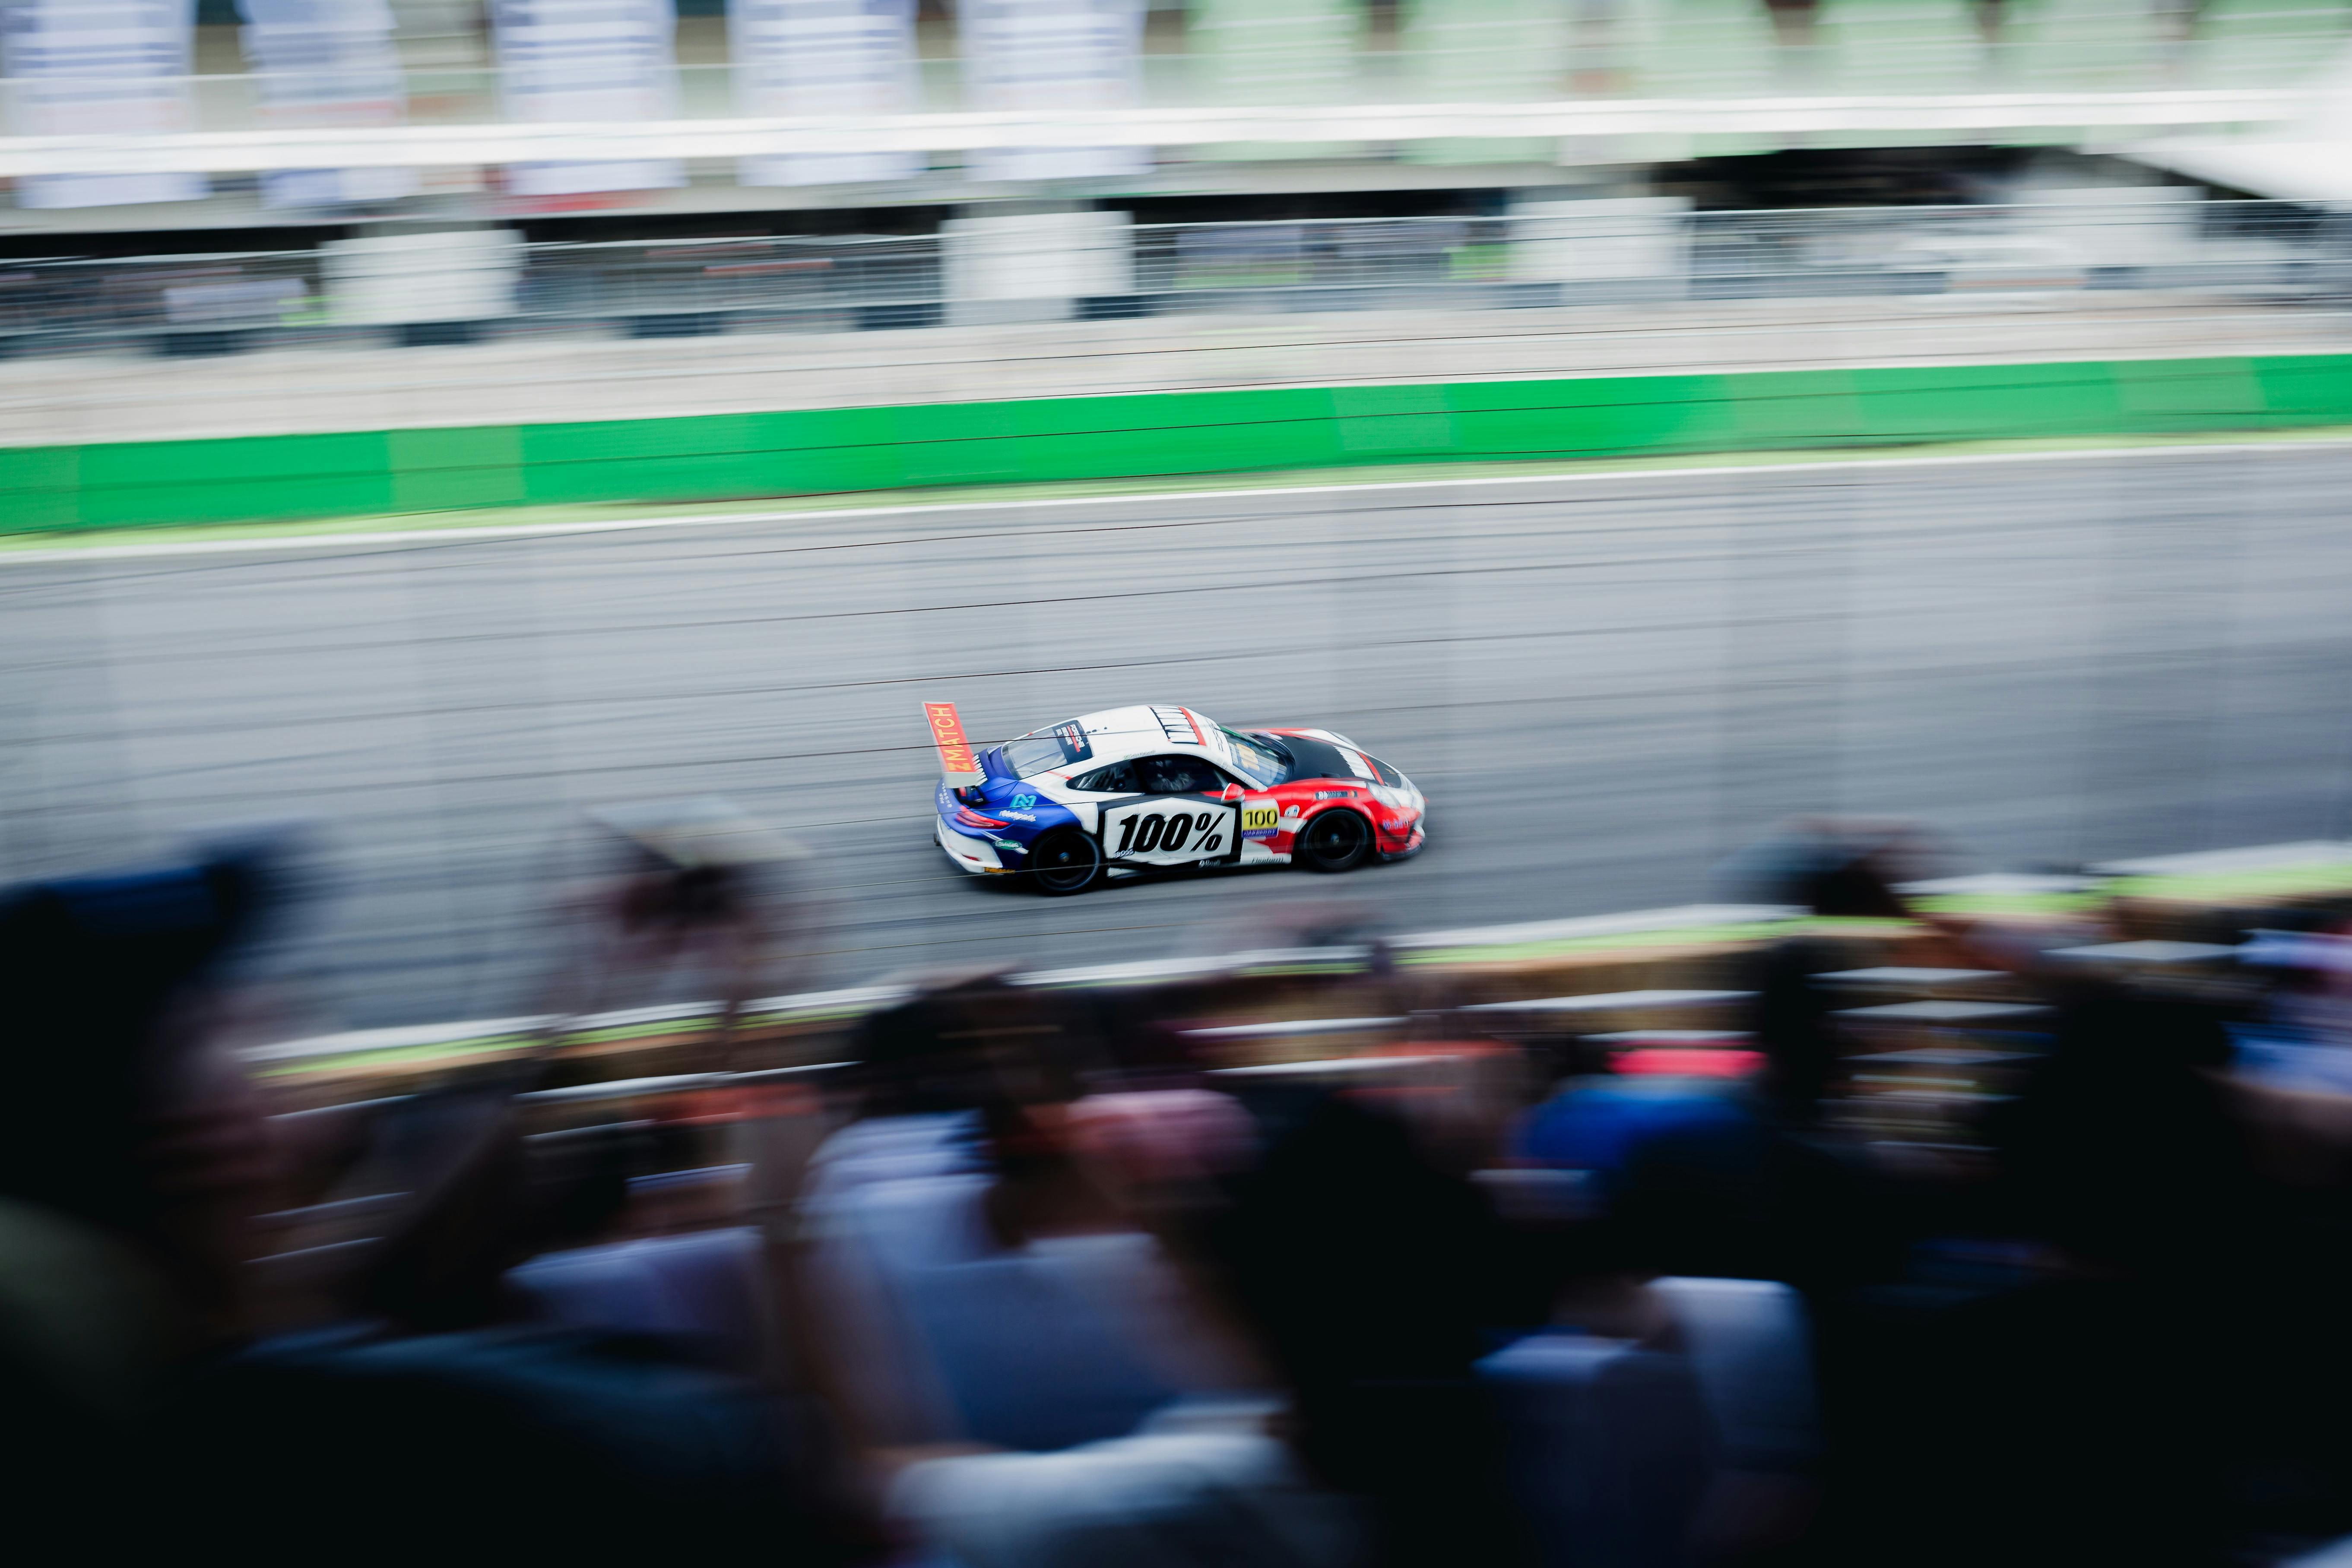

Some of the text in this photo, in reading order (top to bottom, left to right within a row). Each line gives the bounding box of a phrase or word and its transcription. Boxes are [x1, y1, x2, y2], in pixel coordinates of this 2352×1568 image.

[931, 707, 972, 771] ZMATCH
[1119, 811, 1227, 853] 100%
[1246, 810, 1277, 826] 100
